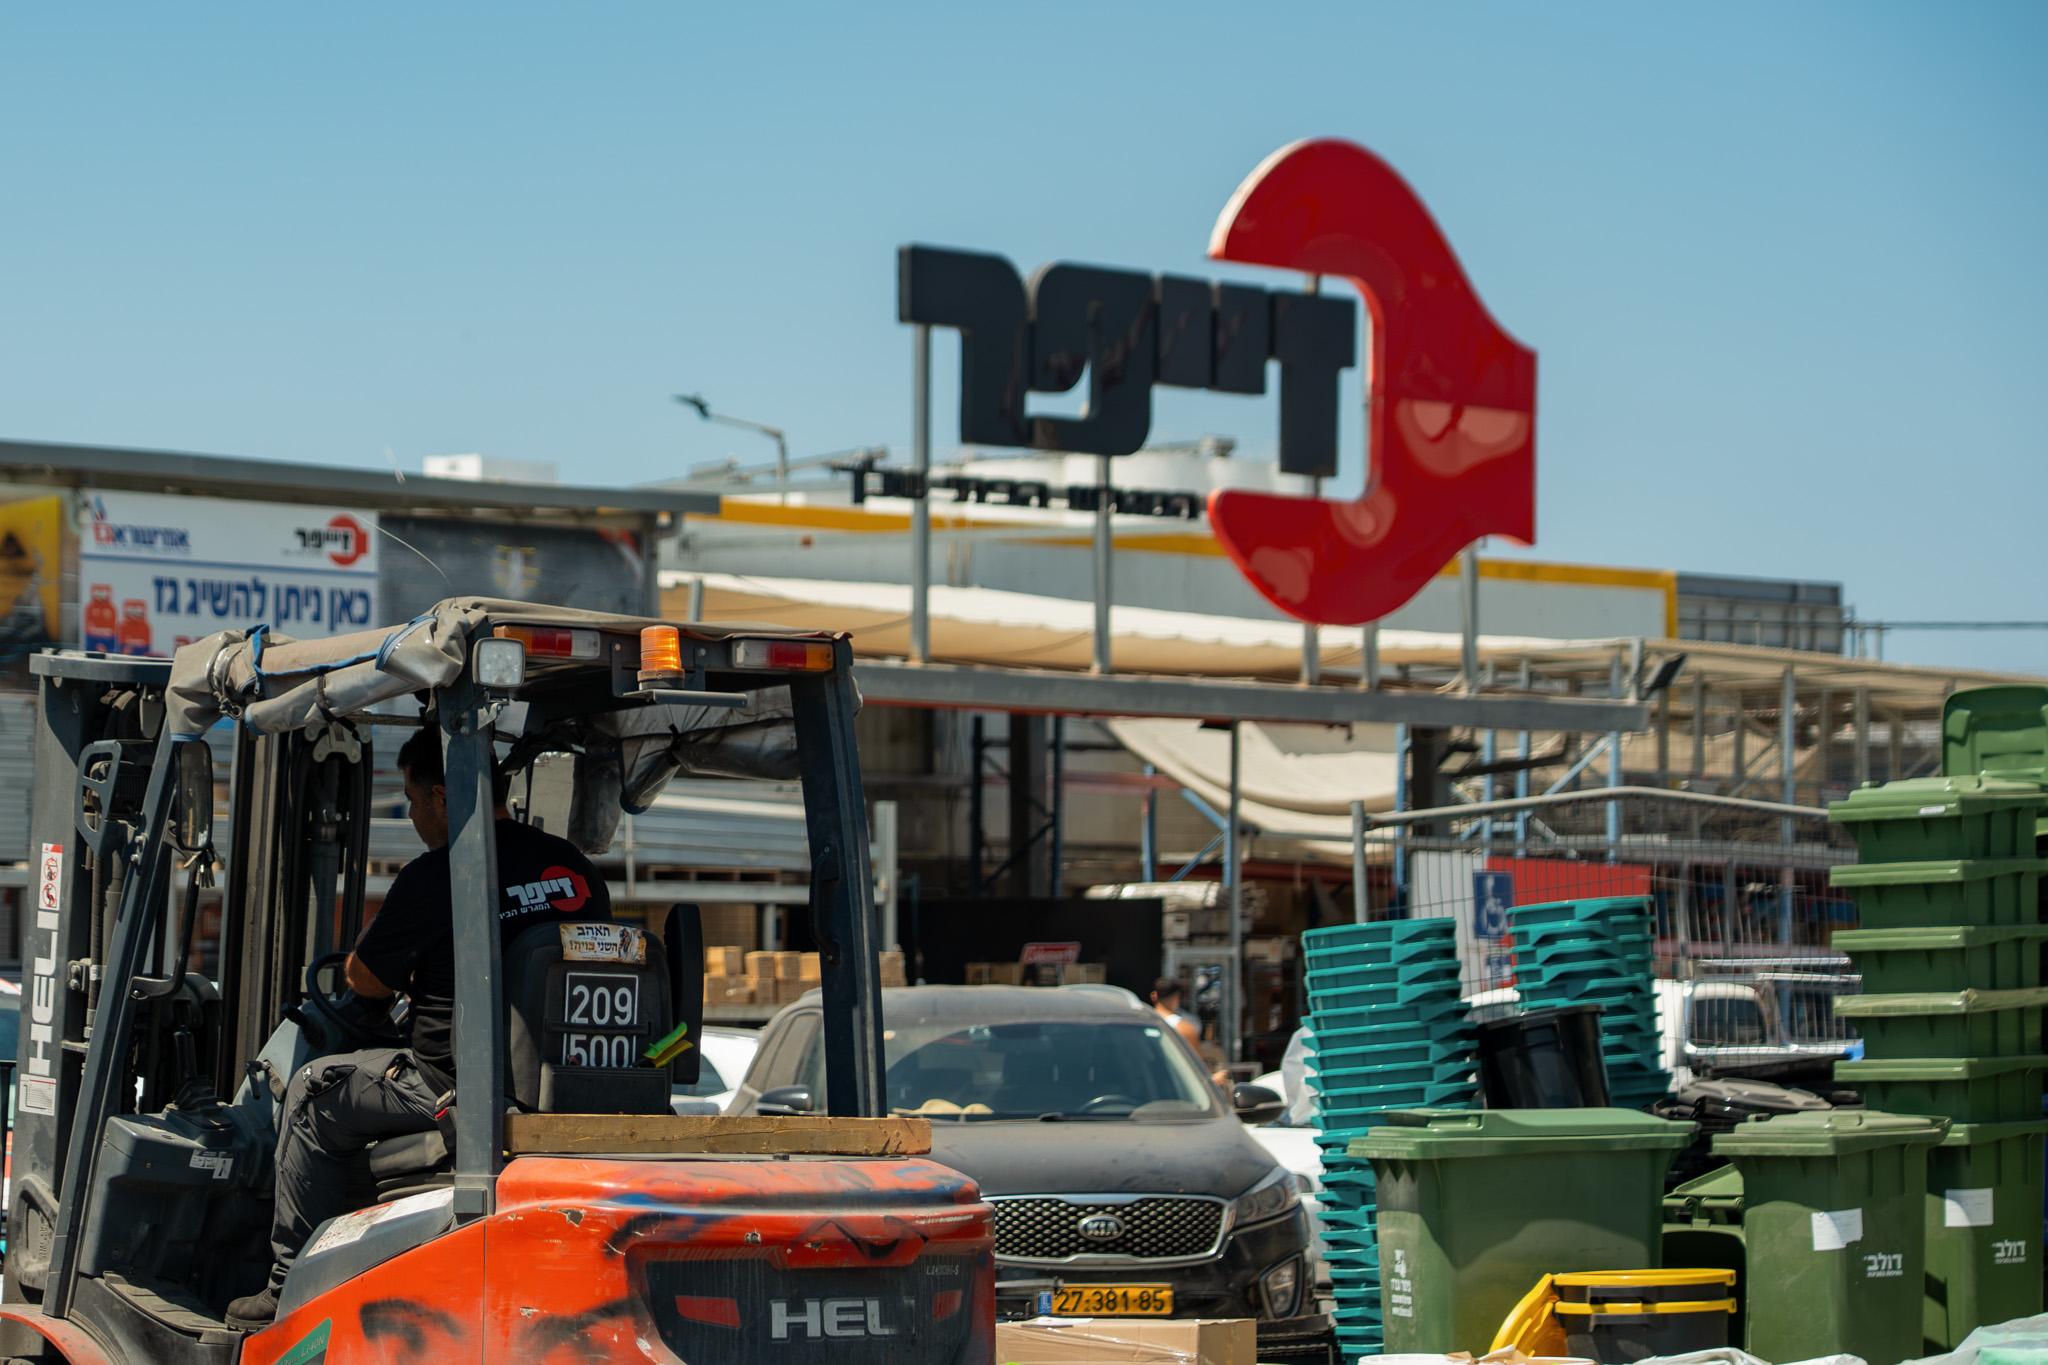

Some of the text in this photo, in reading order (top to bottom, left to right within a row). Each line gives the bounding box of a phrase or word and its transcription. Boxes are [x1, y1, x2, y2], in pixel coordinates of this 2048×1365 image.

[153, 575, 371, 632] כאן ניתן להשיג גז
[520, 902, 551, 914] המגרש
[576, 925, 610, 937] תאהב
[28, 911, 59, 1075] HELI
[571, 985, 632, 1025] 209
[569, 1034, 630, 1068] 500
